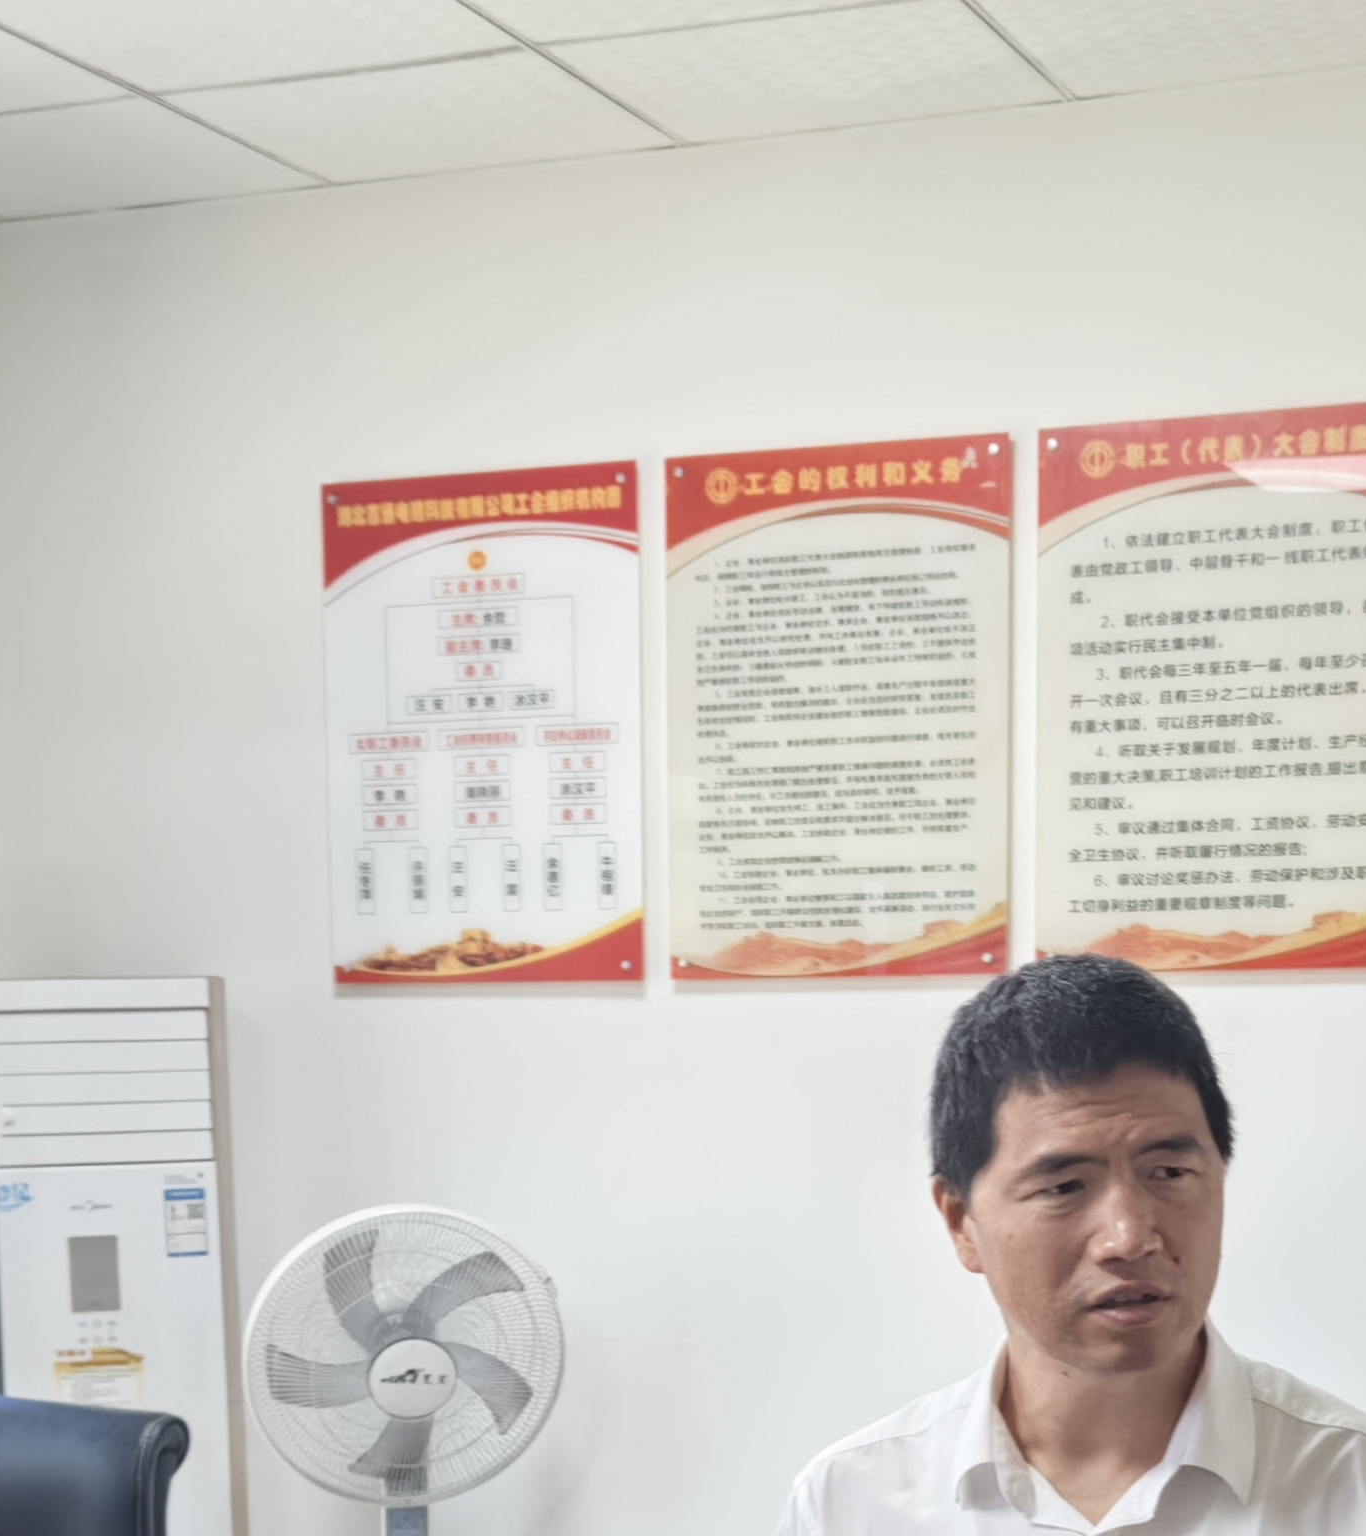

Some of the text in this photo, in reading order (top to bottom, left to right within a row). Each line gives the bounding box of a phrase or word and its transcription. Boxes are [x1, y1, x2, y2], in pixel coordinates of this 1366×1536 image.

[745, 456, 964, 496] 工会的权利和义务
